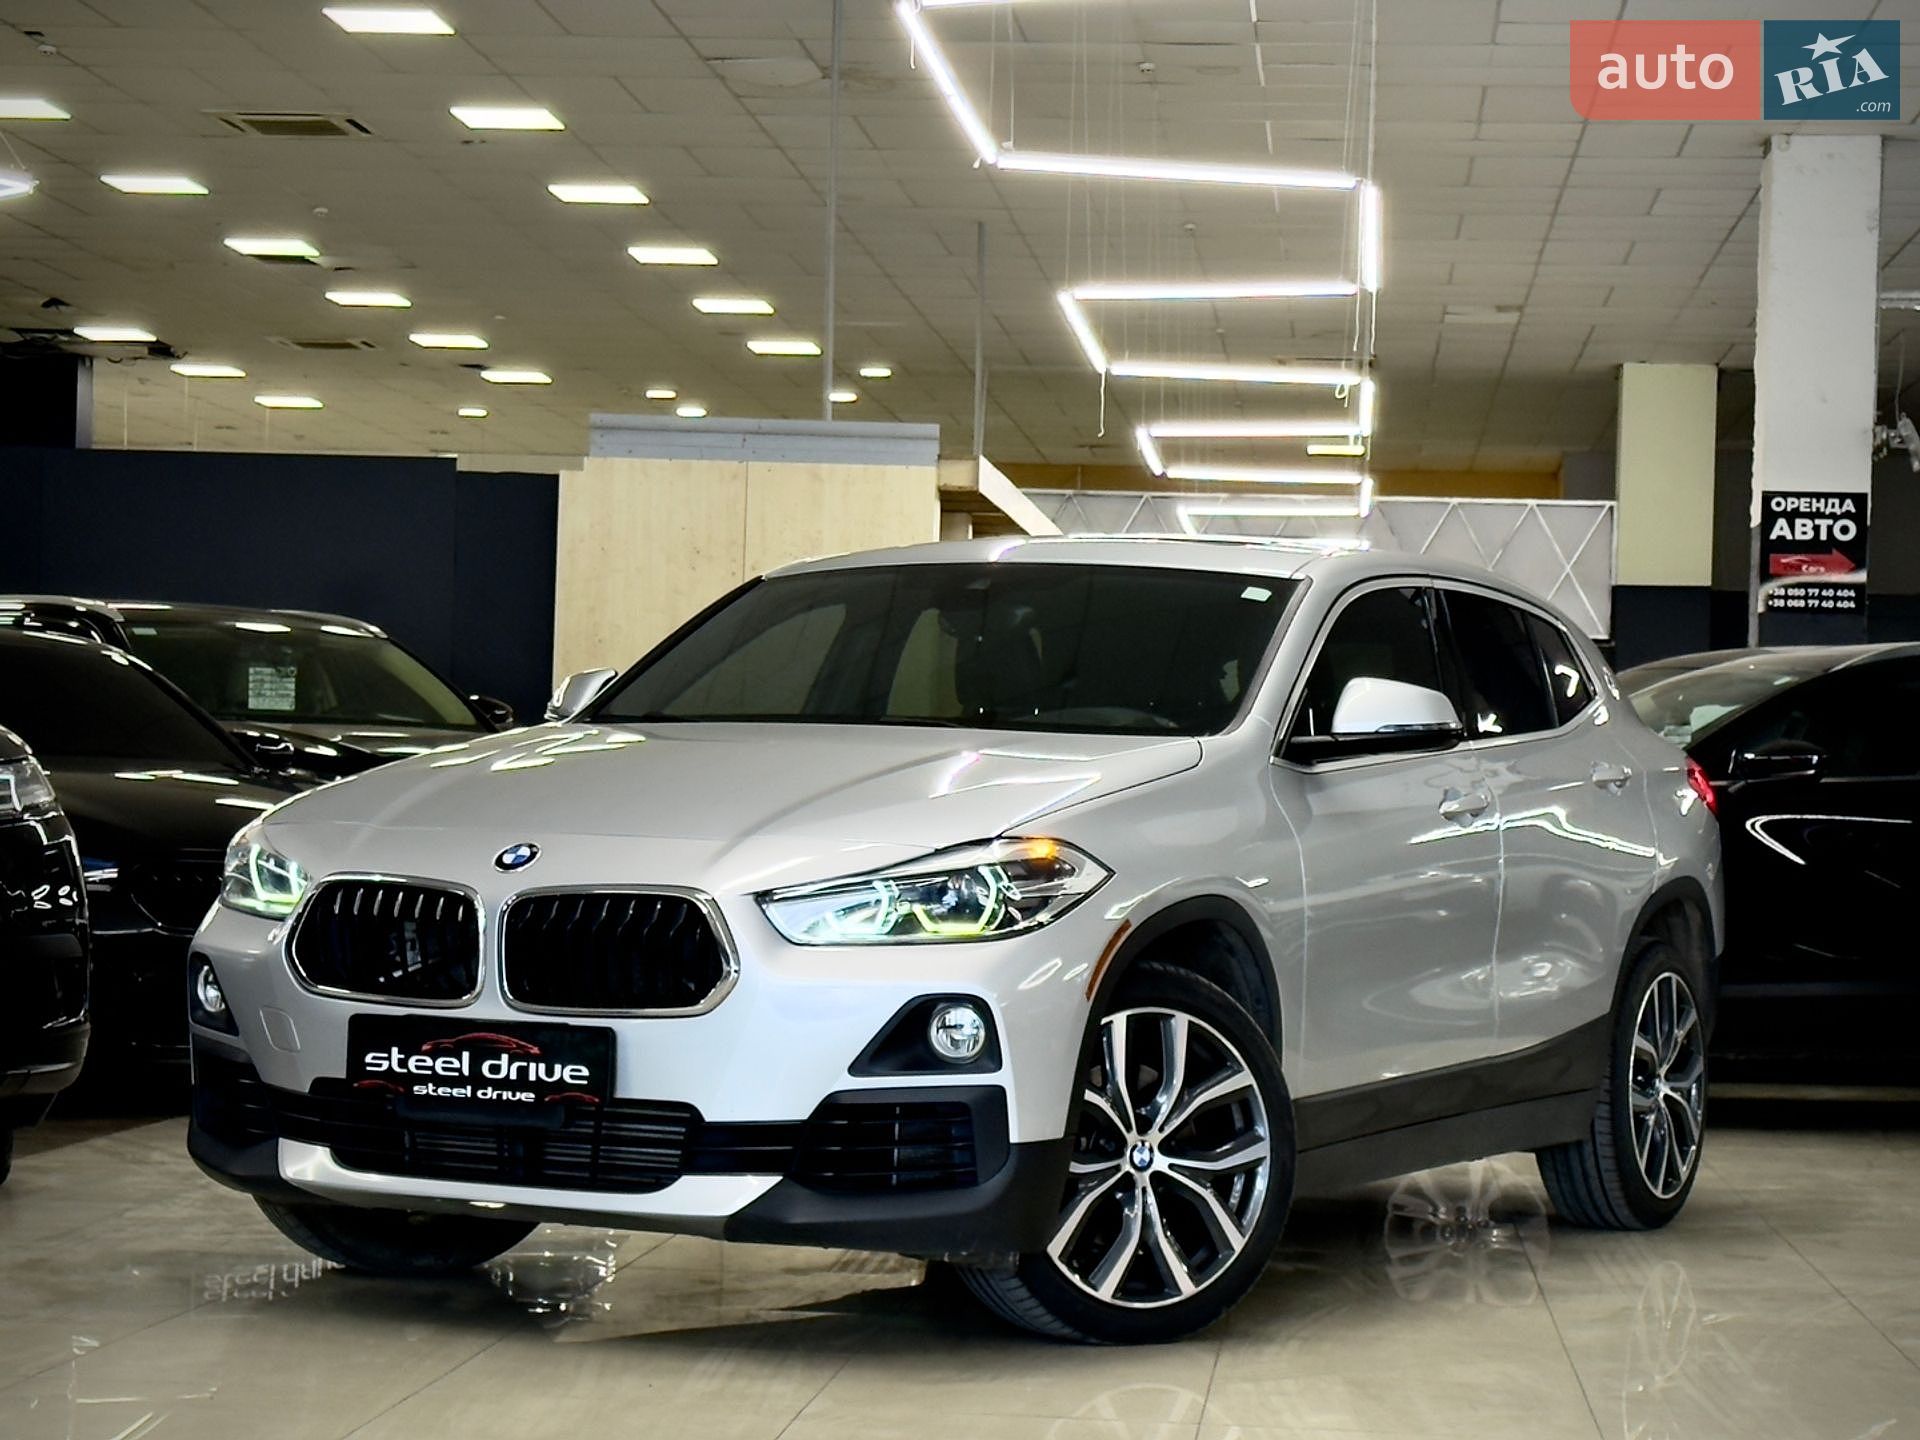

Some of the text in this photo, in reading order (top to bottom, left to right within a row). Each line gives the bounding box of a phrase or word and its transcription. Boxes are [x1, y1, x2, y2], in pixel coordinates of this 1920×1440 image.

[1770, 497, 1856, 515] ОРЕНДА
[1769, 518, 1857, 541] АВТО
[1807, 588, 1820, 597] 77
[1821, 589, 1835, 598] 40
[1836, 589, 1856, 598] 404
[1807, 599, 1820, 608] 77
[1821, 600, 1835, 609] 40
[1836, 600, 1856, 609] 404
[364, 1046, 591, 1085] steel drive
[412, 1082, 536, 1102] steel drive
